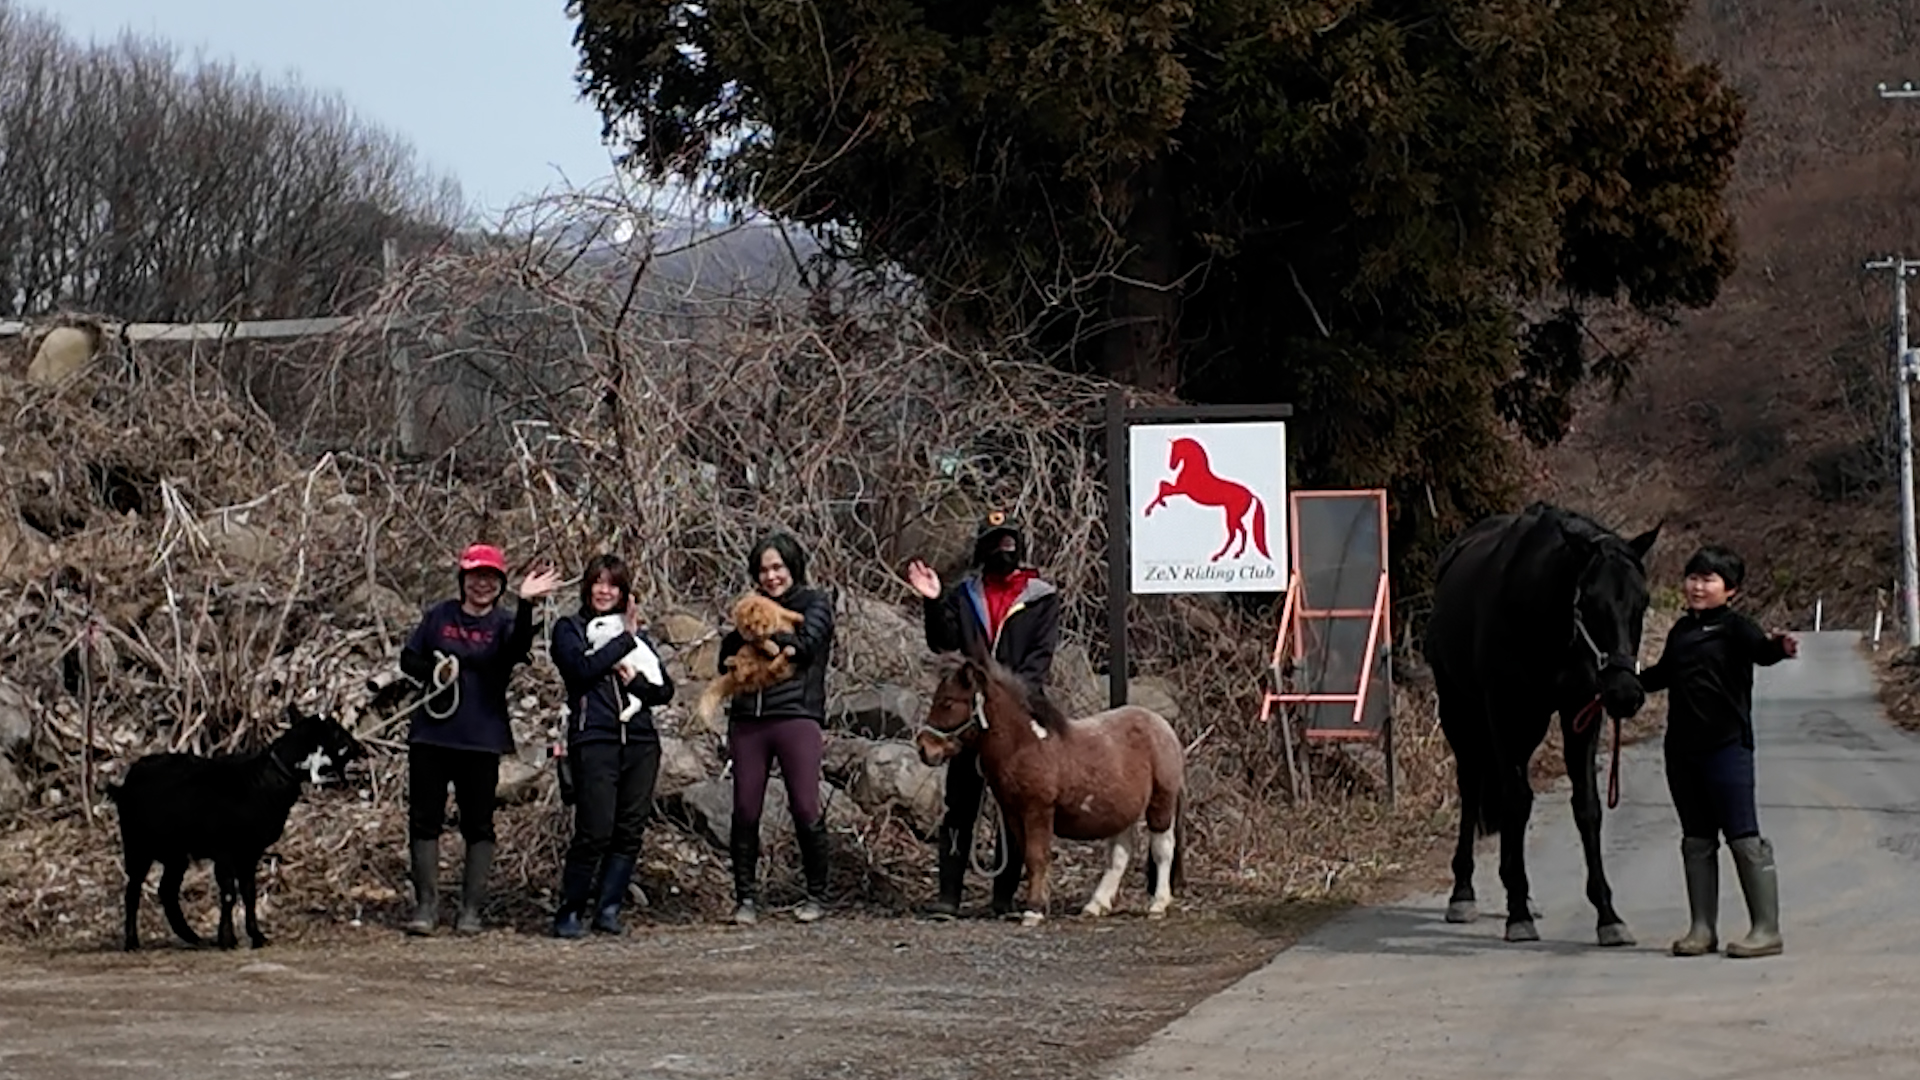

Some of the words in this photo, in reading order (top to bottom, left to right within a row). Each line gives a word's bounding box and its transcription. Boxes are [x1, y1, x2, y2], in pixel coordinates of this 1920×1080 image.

[1145, 566, 1180, 581] ZeN
[1184, 565, 1235, 582] Riding
[1239, 564, 1275, 579] Club
